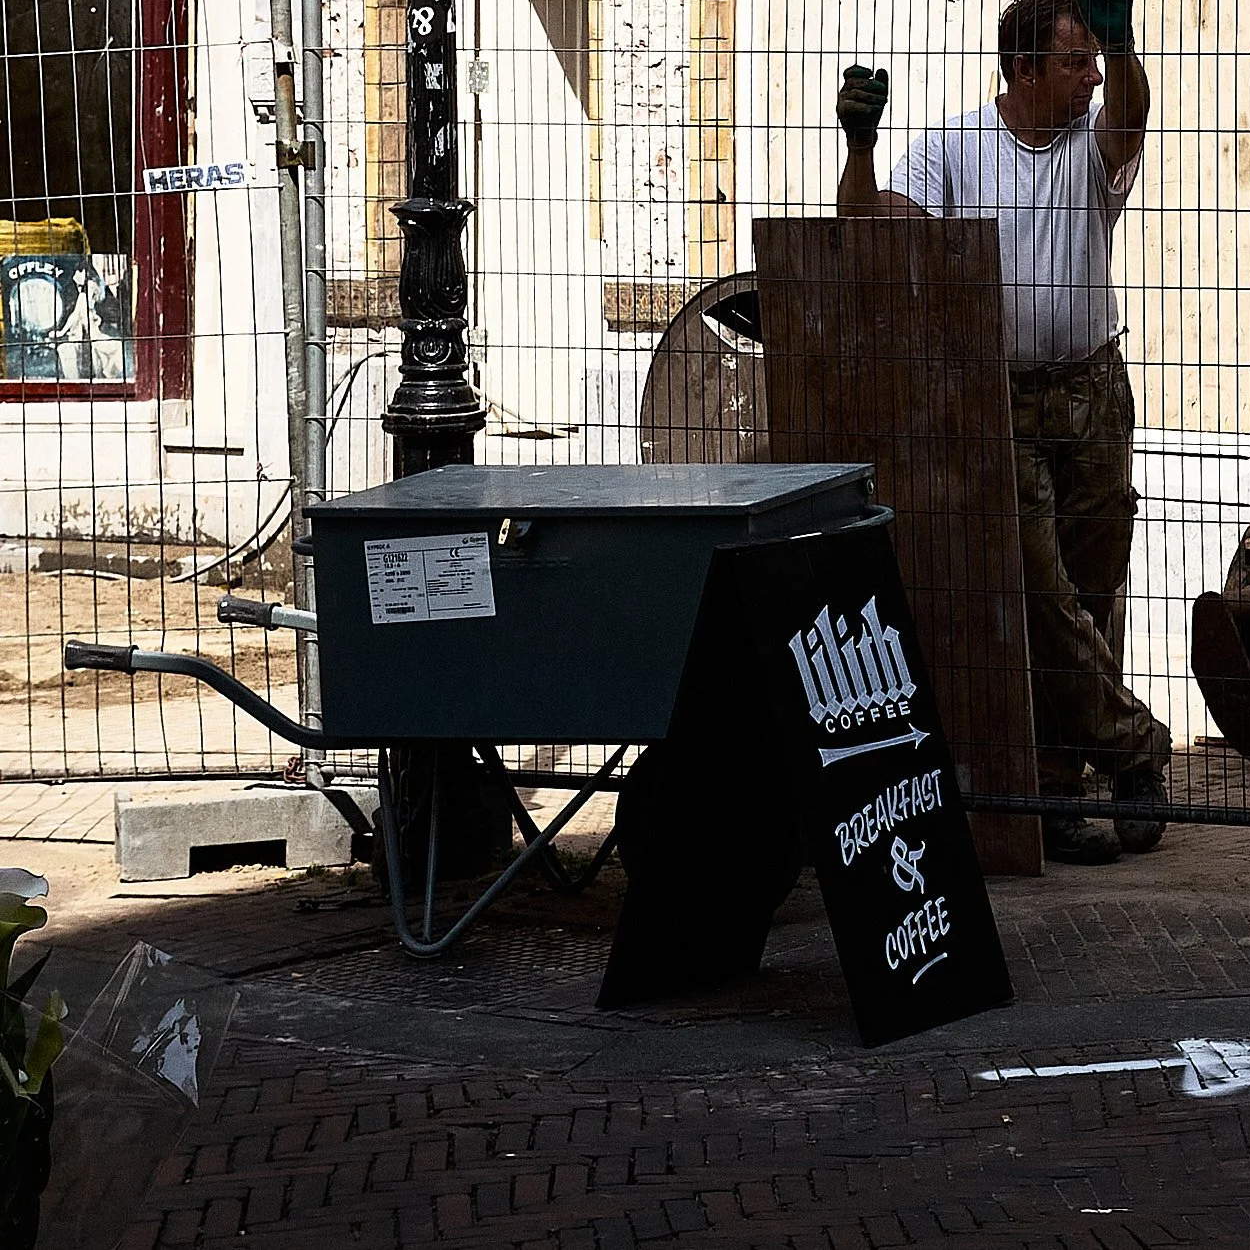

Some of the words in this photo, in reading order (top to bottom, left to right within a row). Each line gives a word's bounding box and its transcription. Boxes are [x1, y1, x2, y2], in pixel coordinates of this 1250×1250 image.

[148, 162, 245, 192] HERAS
[8, 261, 64, 280] OFFLEY
[788, 595, 917, 724] lilith
[825, 701, 911, 733] COFFEE
[834, 769, 942, 866] BREAKFAST
[890, 836, 926, 895] &
[886, 896, 951, 970] COFFEE
